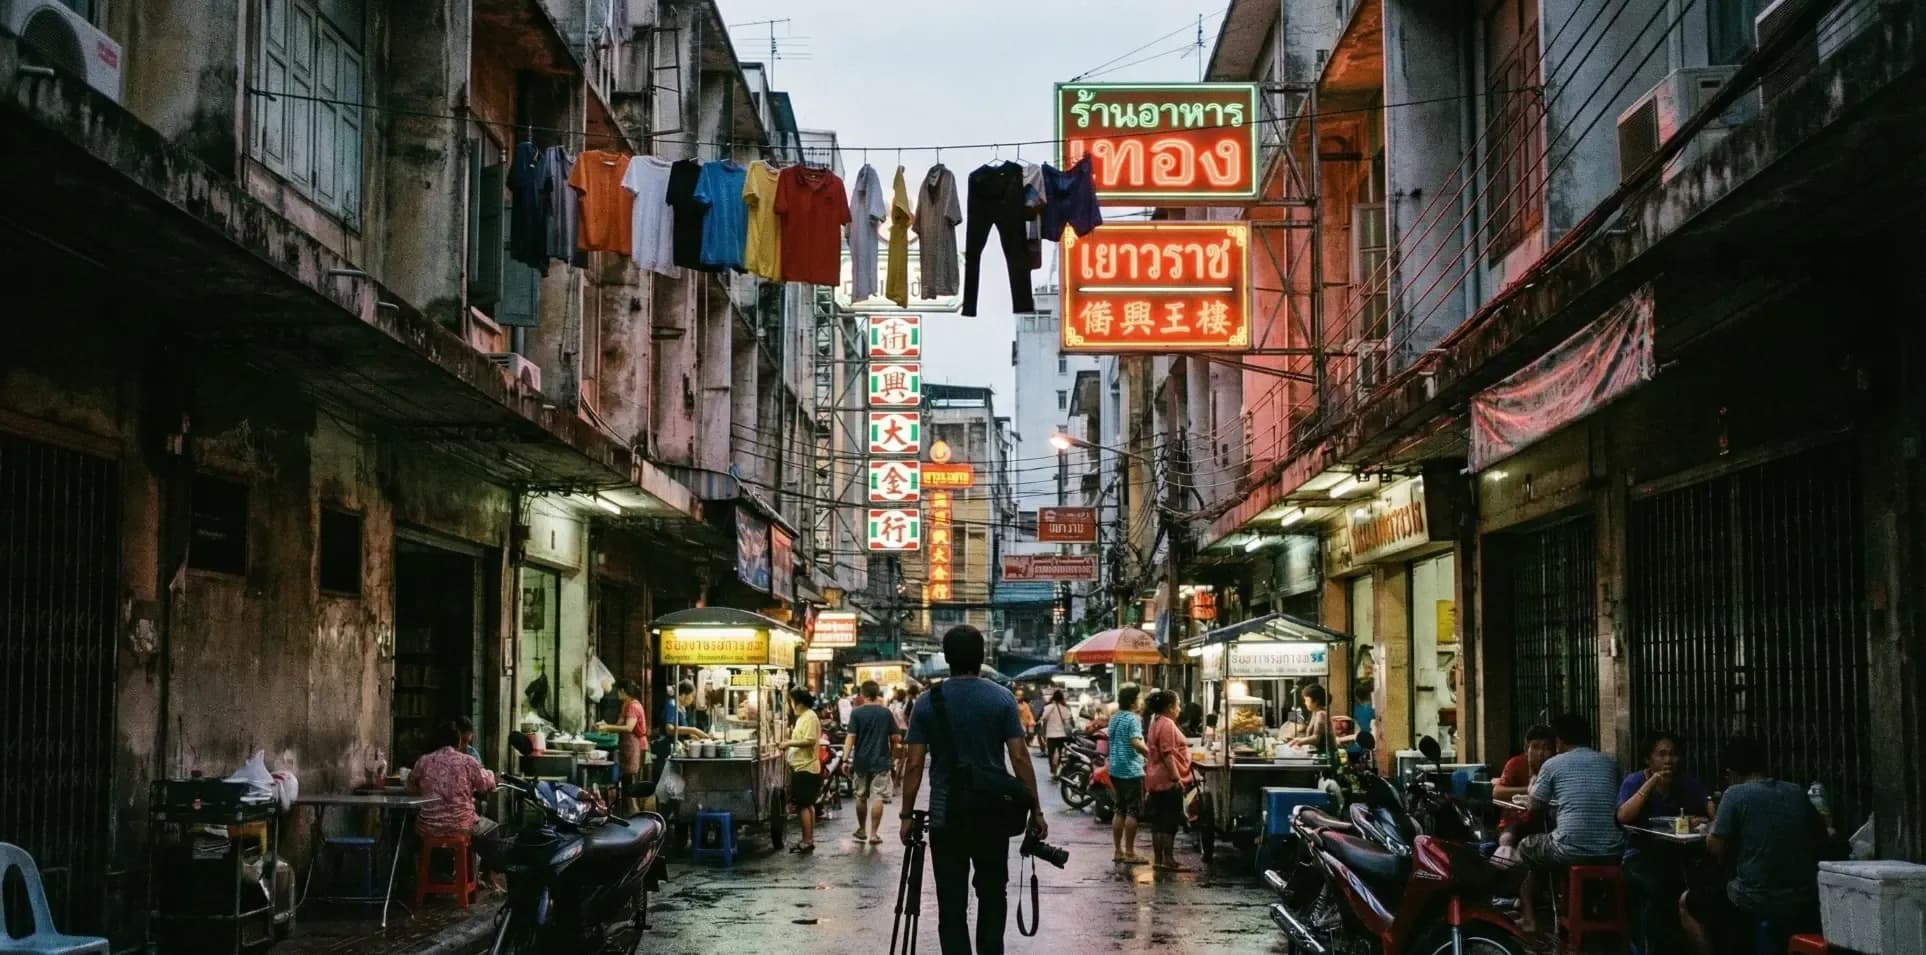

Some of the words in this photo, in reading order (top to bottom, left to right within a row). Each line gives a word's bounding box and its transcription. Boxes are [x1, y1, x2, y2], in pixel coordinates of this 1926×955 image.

[1070, 90, 1243, 128] ร้านอาหาร
[1080, 239, 1232, 280] เยาวราช
